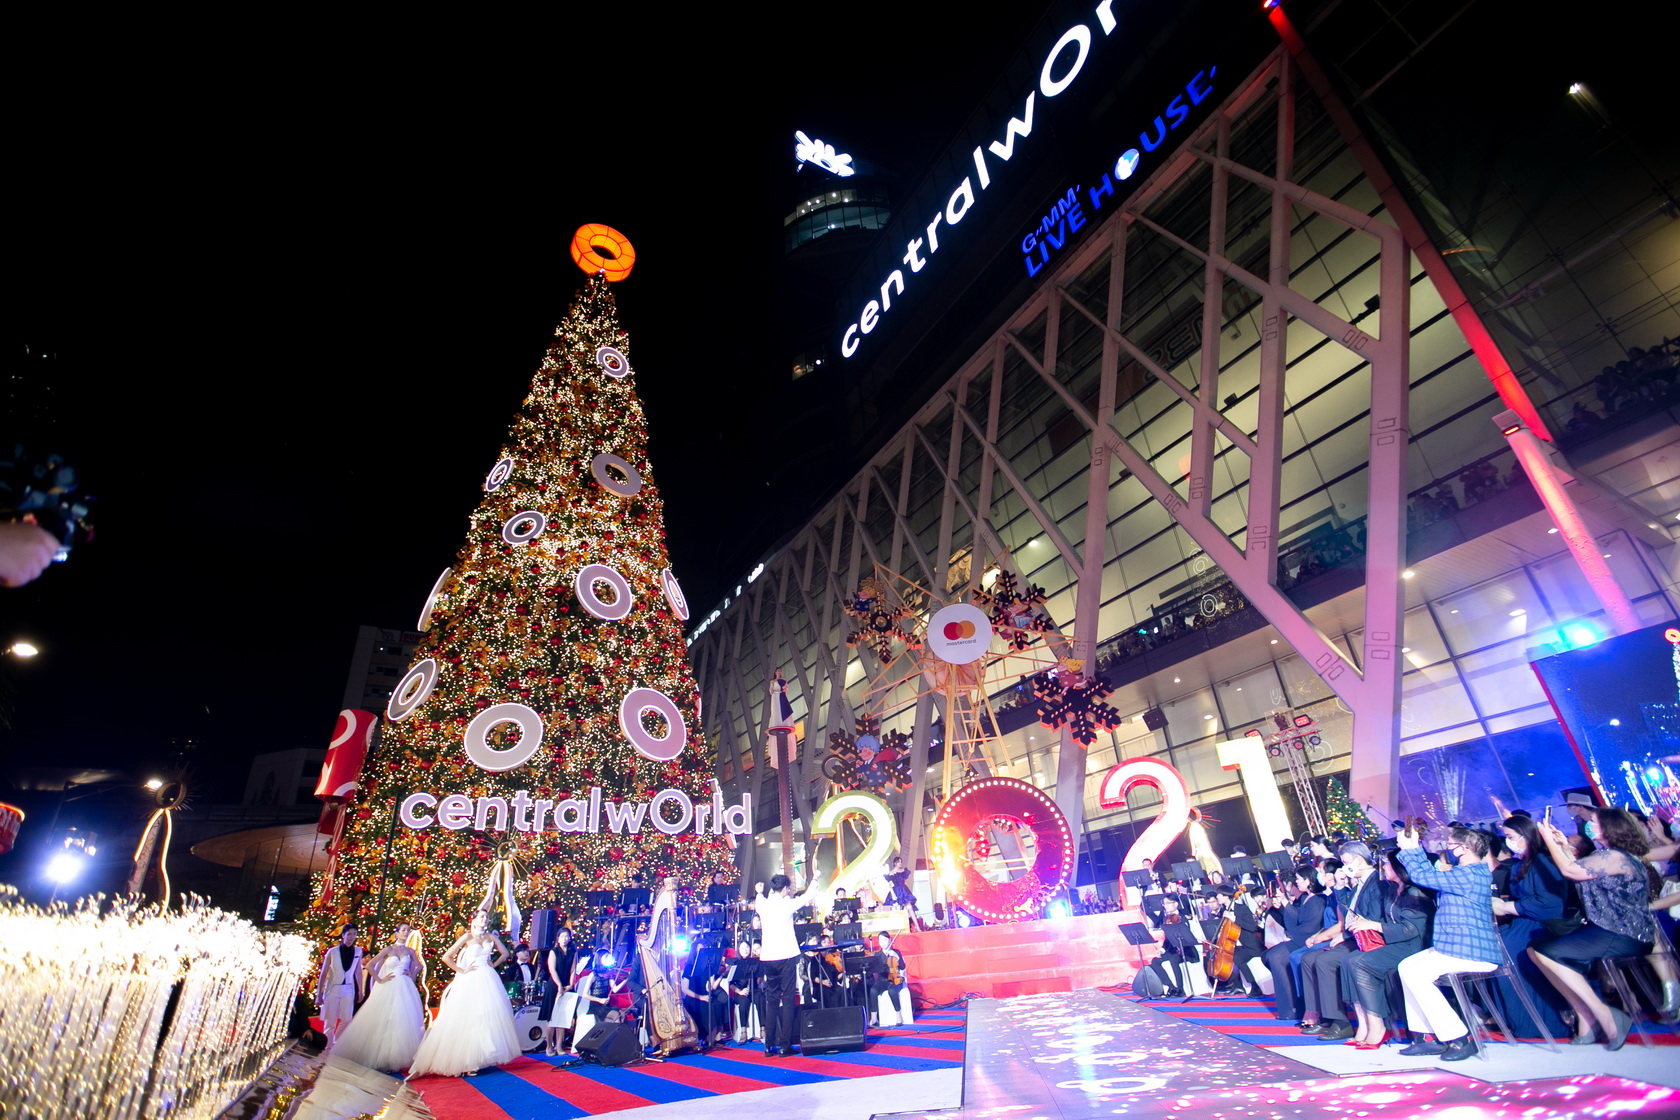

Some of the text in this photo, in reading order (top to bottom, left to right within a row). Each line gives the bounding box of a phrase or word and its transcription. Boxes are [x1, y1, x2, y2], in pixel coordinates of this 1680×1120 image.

[1025, 202, 1087, 279] LIVE
[946, 639, 977, 647] mastercard
[400, 786, 753, 835] centralwOrld
